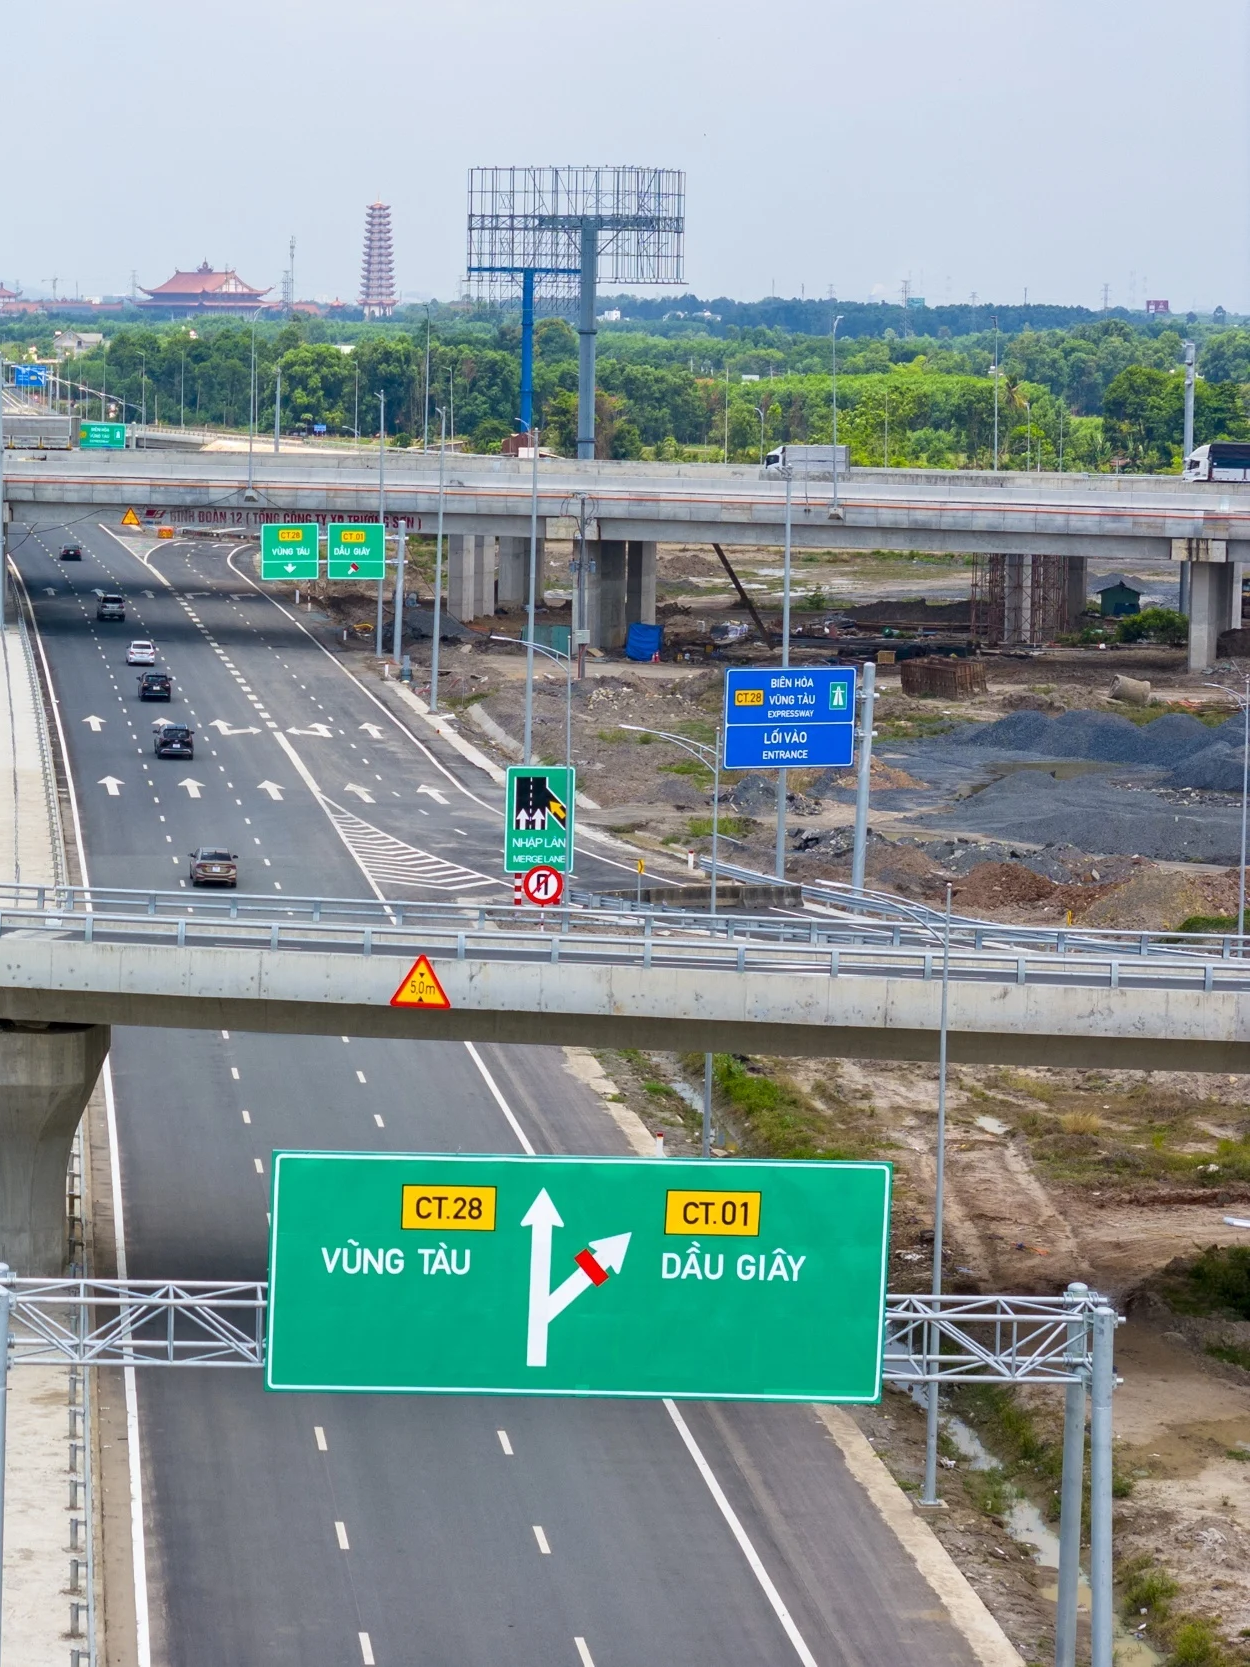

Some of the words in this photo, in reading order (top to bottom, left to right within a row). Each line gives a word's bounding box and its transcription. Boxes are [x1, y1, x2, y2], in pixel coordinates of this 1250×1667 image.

[231, 511, 243, 524] 12
[283, 509, 312, 524] CÔNG
[315, 513, 327, 526] TY
[771, 676, 792, 688] BIÊN
[795, 675, 814, 688] HÒA
[736, 692, 762, 703] CT.28
[769, 694, 794, 705] VŨNG
[797, 692, 816, 705] TÀU
[767, 709, 814, 718] EXPRESSWAY
[763, 728, 782, 744] LỐI
[784, 729, 807, 744] VÀO
[762, 749, 808, 760] ENTRANCE
[512, 836, 543, 850] NHẬP
[512, 854, 543, 863] MERGE
[543, 855, 566, 863] LANE
[415, 1196, 483, 1220] CT.28
[682, 1200, 749, 1227] CT.01
[321, 1238, 405, 1275] VŨNG
[417, 1242, 471, 1275] TÀU
[661, 1240, 725, 1280] DẦU
[736, 1247, 806, 1282] GIÂY
